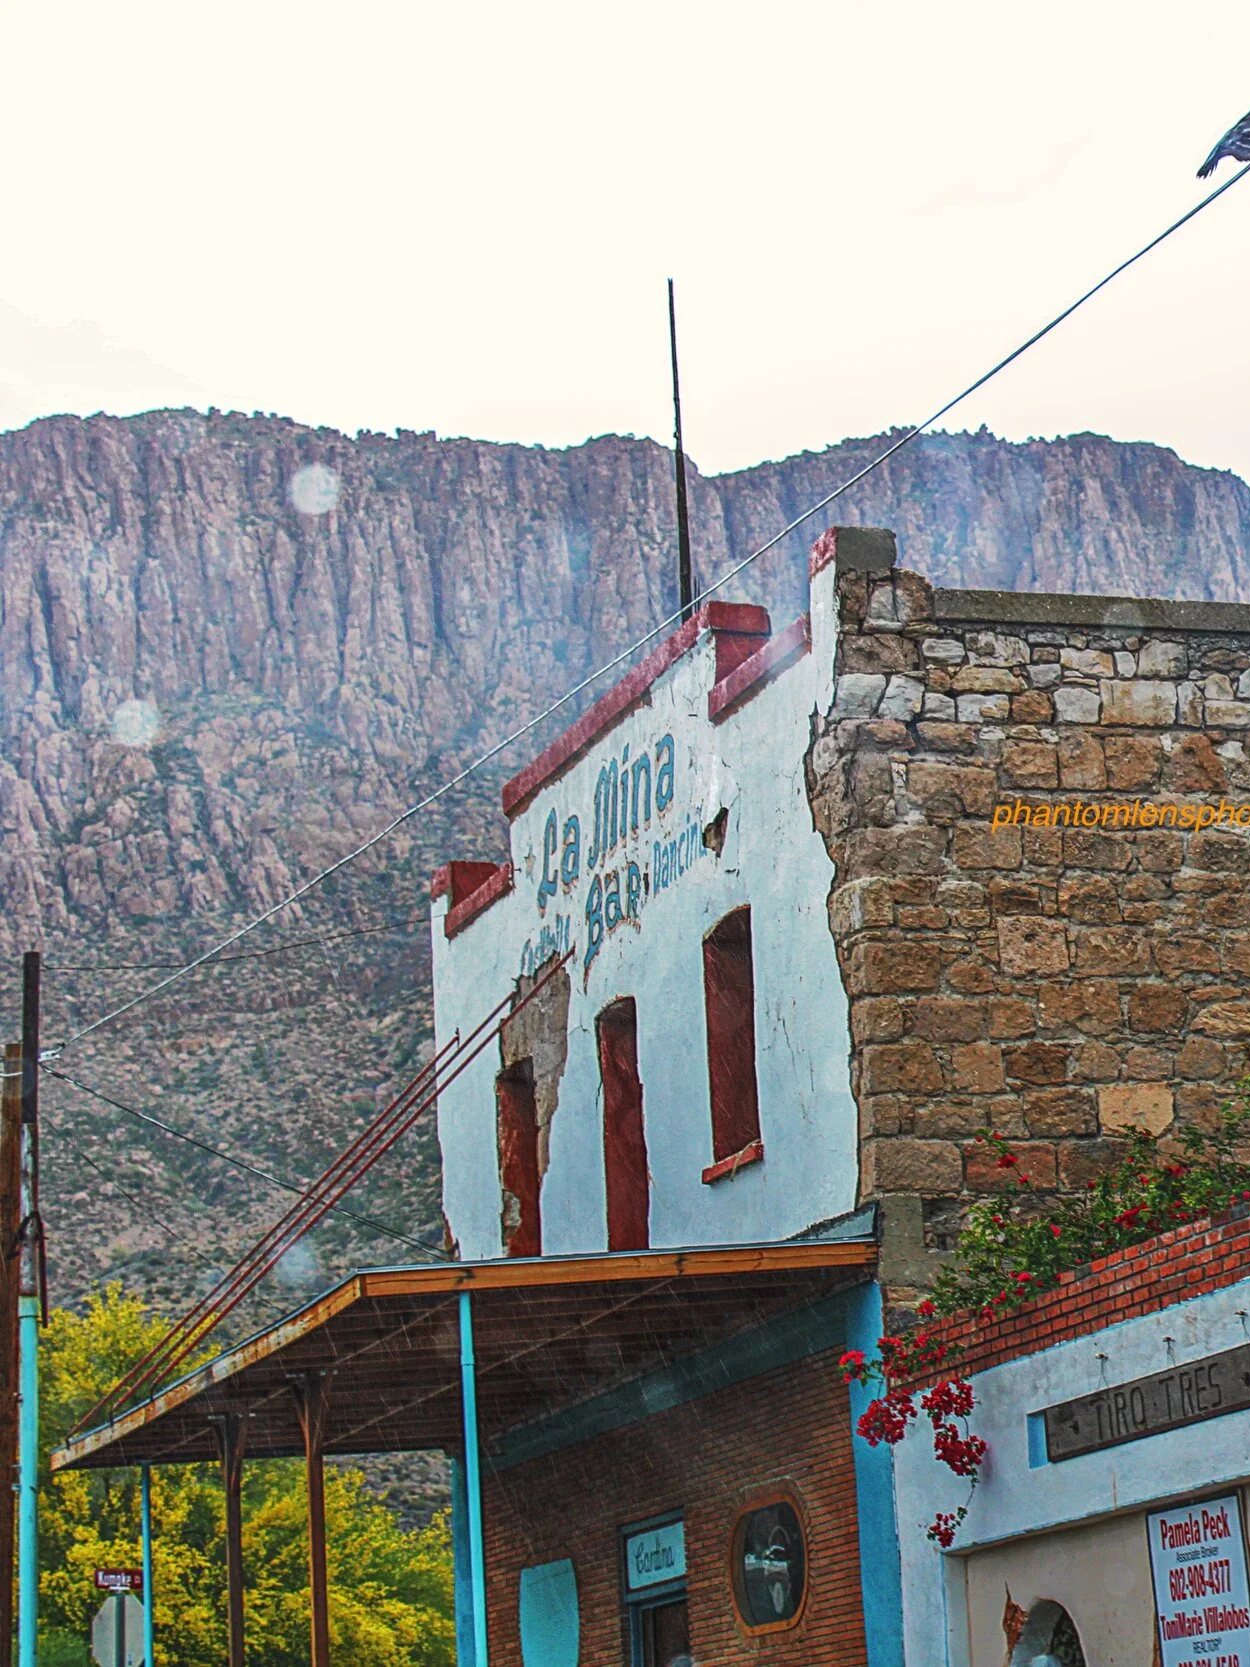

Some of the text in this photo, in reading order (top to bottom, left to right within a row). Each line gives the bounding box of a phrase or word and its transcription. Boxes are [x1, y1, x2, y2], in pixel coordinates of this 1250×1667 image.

[538, 733, 676, 917] La Mina
[1160, 1362, 1222, 1420] TRES
[1160, 1506, 1231, 1550] Pamela Peck
[1169, 1559, 1231, 1602] 602-908-4377
[1203, 1603, 1250, 1634] Villalobos
